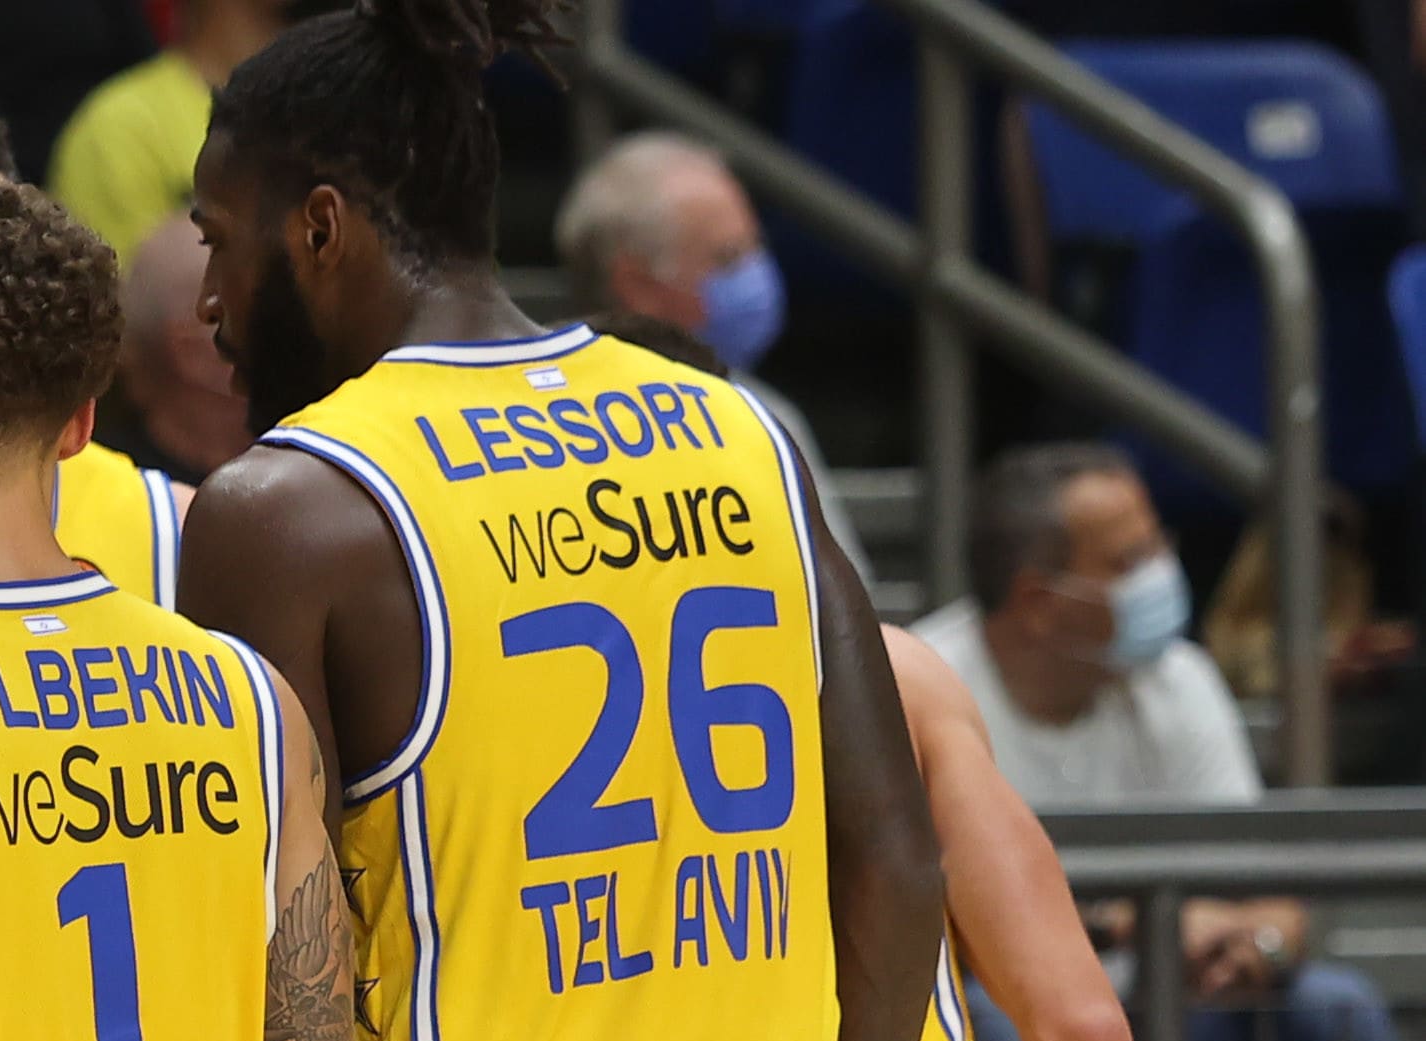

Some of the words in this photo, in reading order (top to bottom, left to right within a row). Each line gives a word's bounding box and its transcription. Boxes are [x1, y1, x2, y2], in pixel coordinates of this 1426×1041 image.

[414, 382, 726, 483] LESSORT
[479, 478, 755, 584] weSure
[499, 585, 796, 861] 26
[520, 870, 654, 995] TEL
